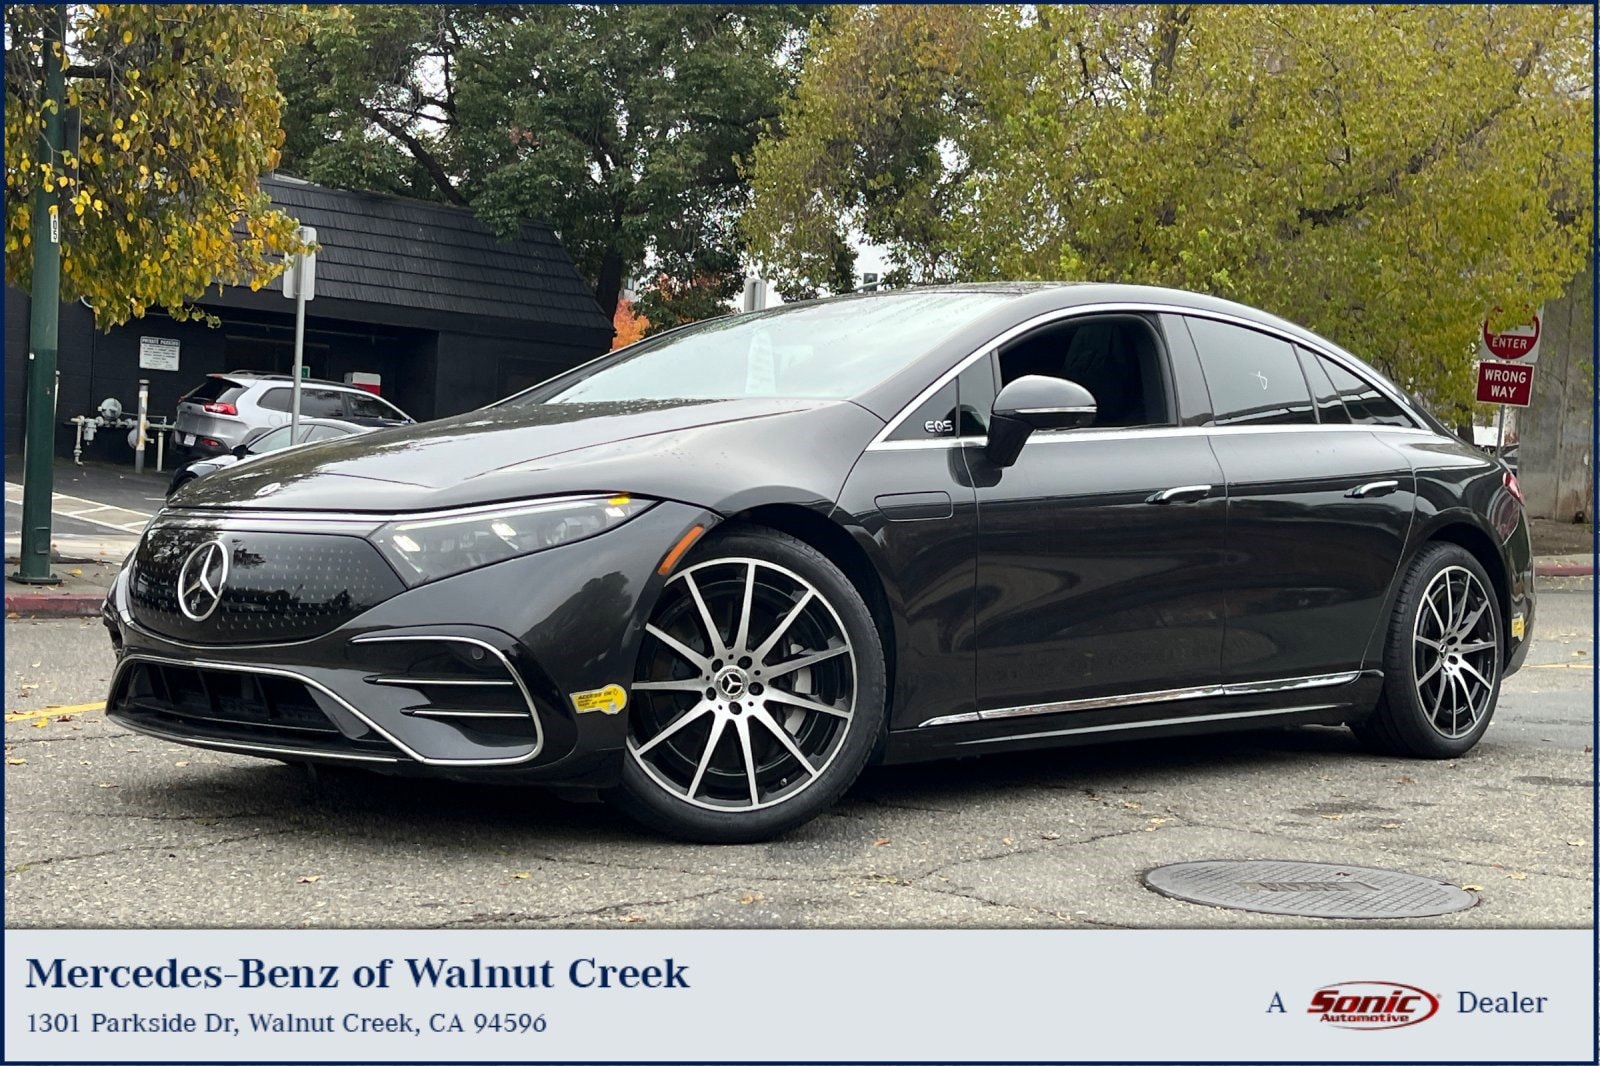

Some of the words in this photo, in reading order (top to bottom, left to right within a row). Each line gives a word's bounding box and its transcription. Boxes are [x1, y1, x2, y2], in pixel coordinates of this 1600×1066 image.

[1492, 336, 1527, 349] ENTER
[1485, 369, 1527, 384] WRONG
[1491, 385, 1517, 399] WAY
[924, 420, 953, 433] EQS
